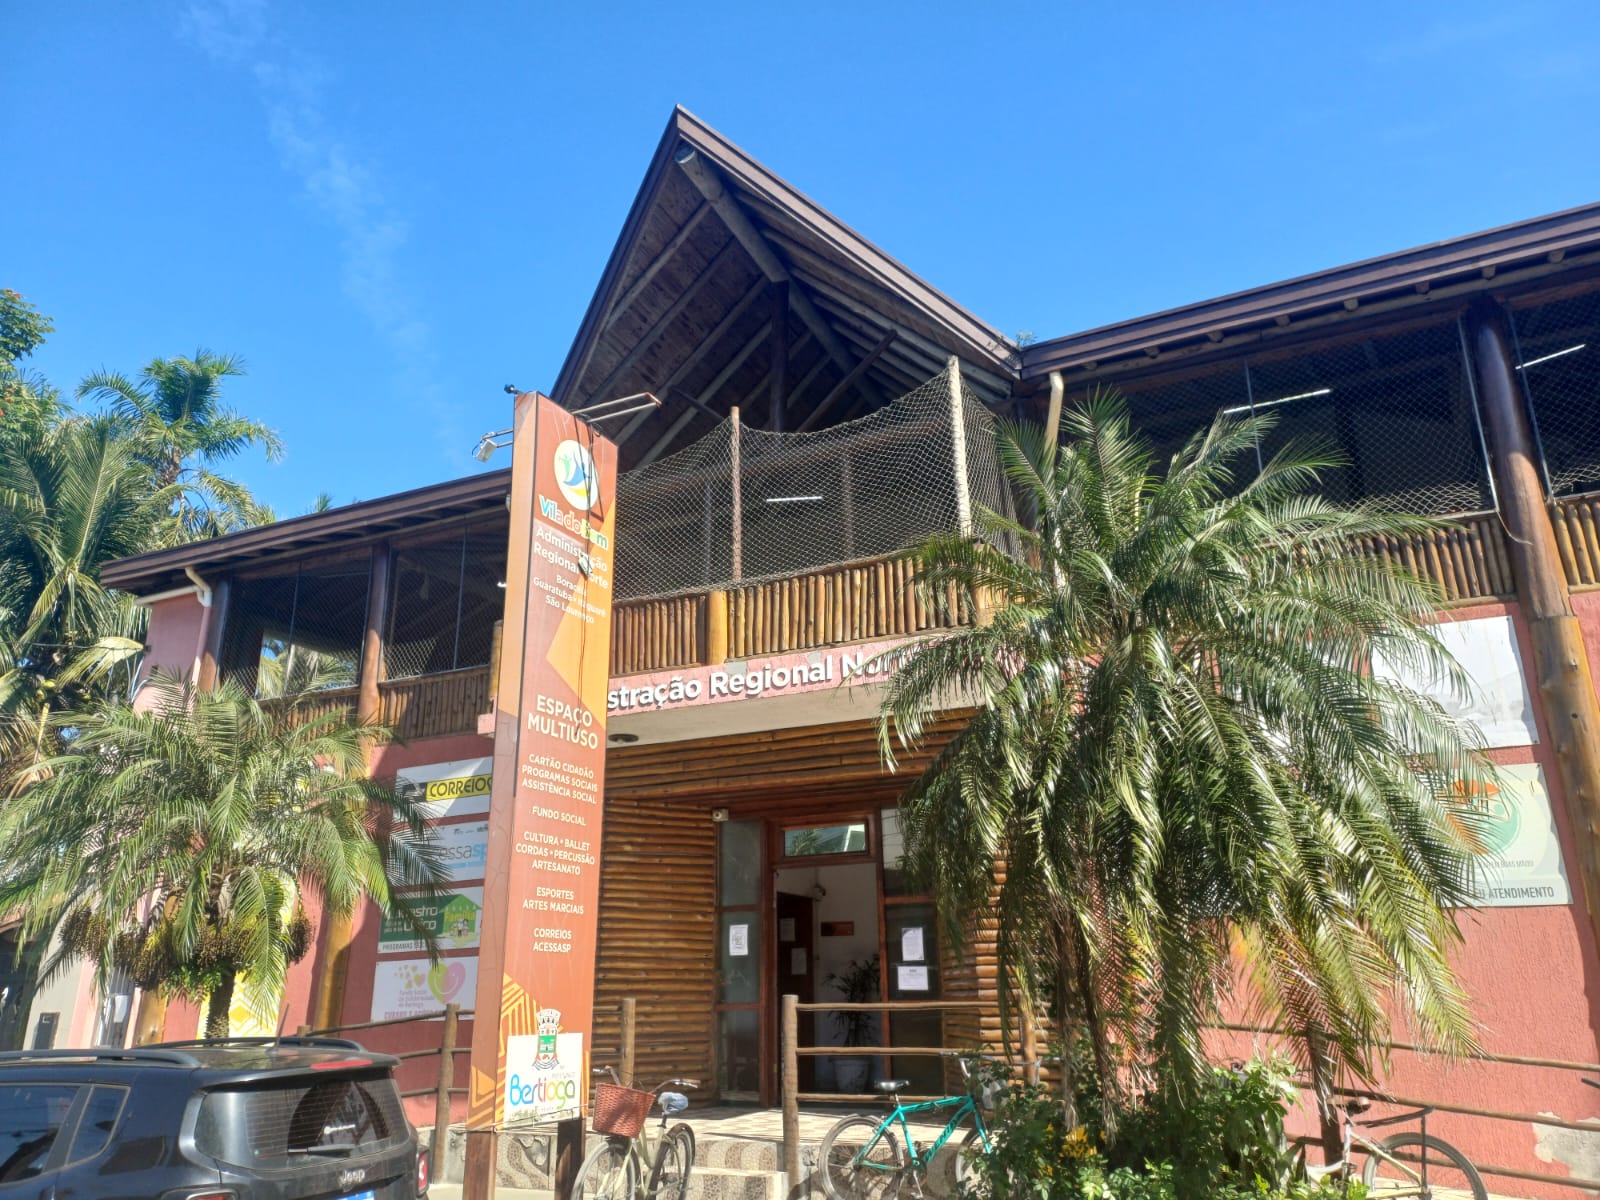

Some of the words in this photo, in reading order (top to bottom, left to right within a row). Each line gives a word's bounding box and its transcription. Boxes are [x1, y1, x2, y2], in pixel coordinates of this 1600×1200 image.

[545, 594, 560, 608] São
[710, 657, 833, 696] Regional
[536, 694, 593, 727] ESPAÇO
[527, 713, 598, 749] MULTIUSO
[528, 753, 561, 770] CARTÃO
[562, 763, 594, 779] CIDADÃO
[522, 764, 570, 785] PROGRAMAS
[571, 777, 598, 792] SOCIAIS
[522, 778, 571, 797] ASSISTÊNCIA
[572, 790, 597, 804] SOCIAL
[532, 806, 559, 820] FUNDO
[560, 813, 587, 826] SOCIAL
[524, 831, 559, 846] CULTURA
[564, 838, 590, 851] BALLET
[515, 843, 549, 857] CORDAS
[554, 850, 595, 865] PERCUSSÃO
[531, 859, 581, 876] ARTESANATO
[536, 887, 574, 900] ESPORTES
[1489, 886, 1555, 899] ATENDIMENTO
[522, 899, 548, 911] ARTES
[549, 902, 584, 914] MARCIAIS
[533, 927, 572, 940] CORREIOS
[533, 941, 572, 953] ACESSASP
[509, 1073, 576, 1109] Bertioga
